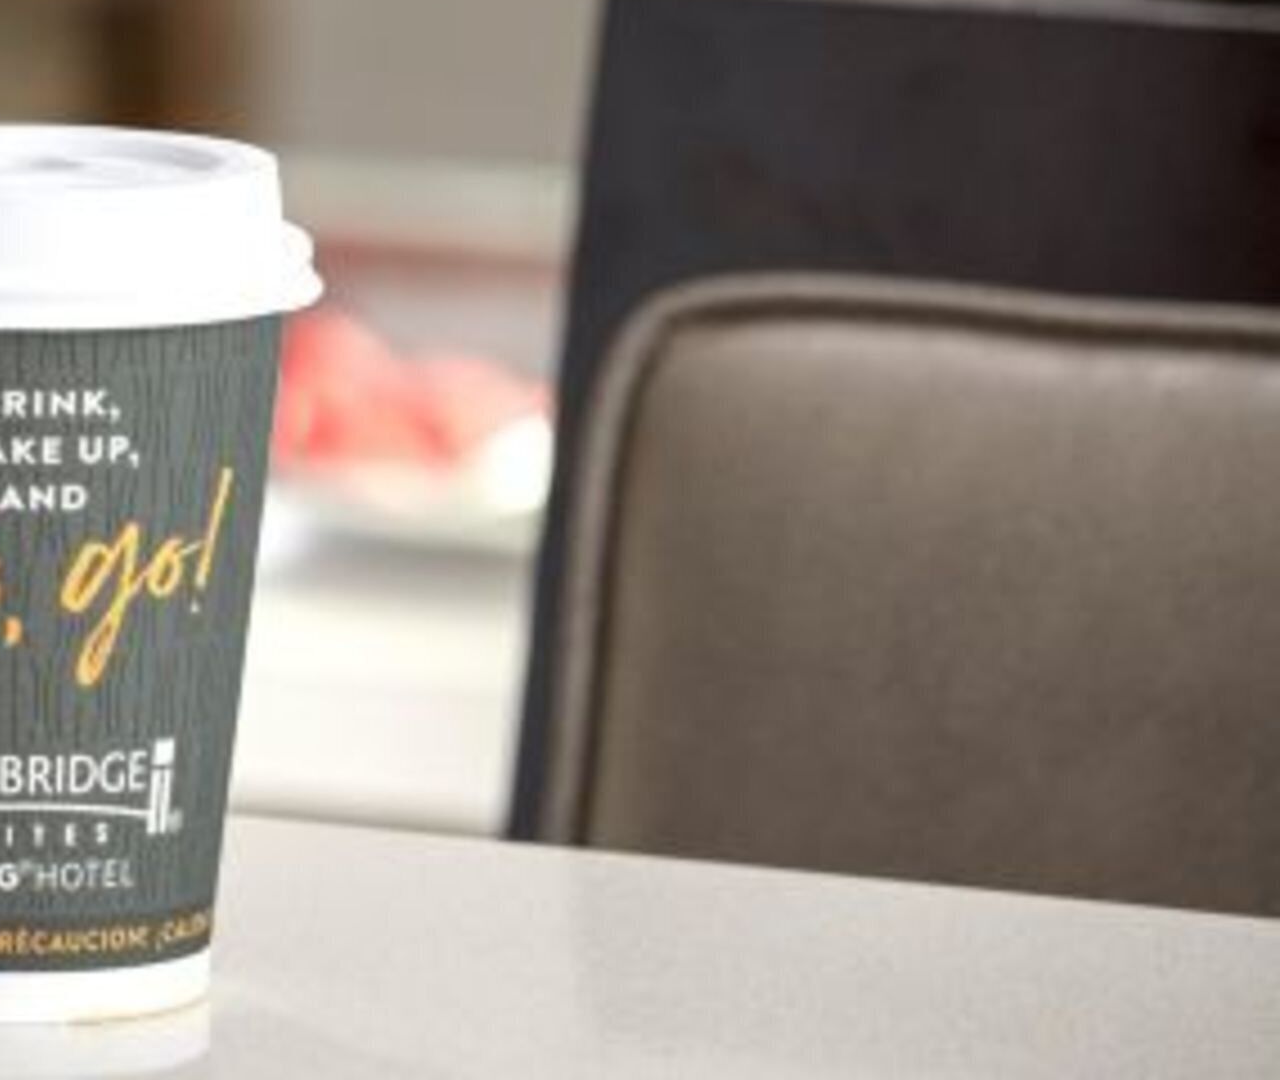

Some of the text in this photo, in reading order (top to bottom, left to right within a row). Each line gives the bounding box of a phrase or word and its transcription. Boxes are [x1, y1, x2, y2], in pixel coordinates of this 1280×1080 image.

[77, 434, 140, 469] UP,
[60, 466, 234, 687] go!
[36, 856, 135, 892] HOTEL
